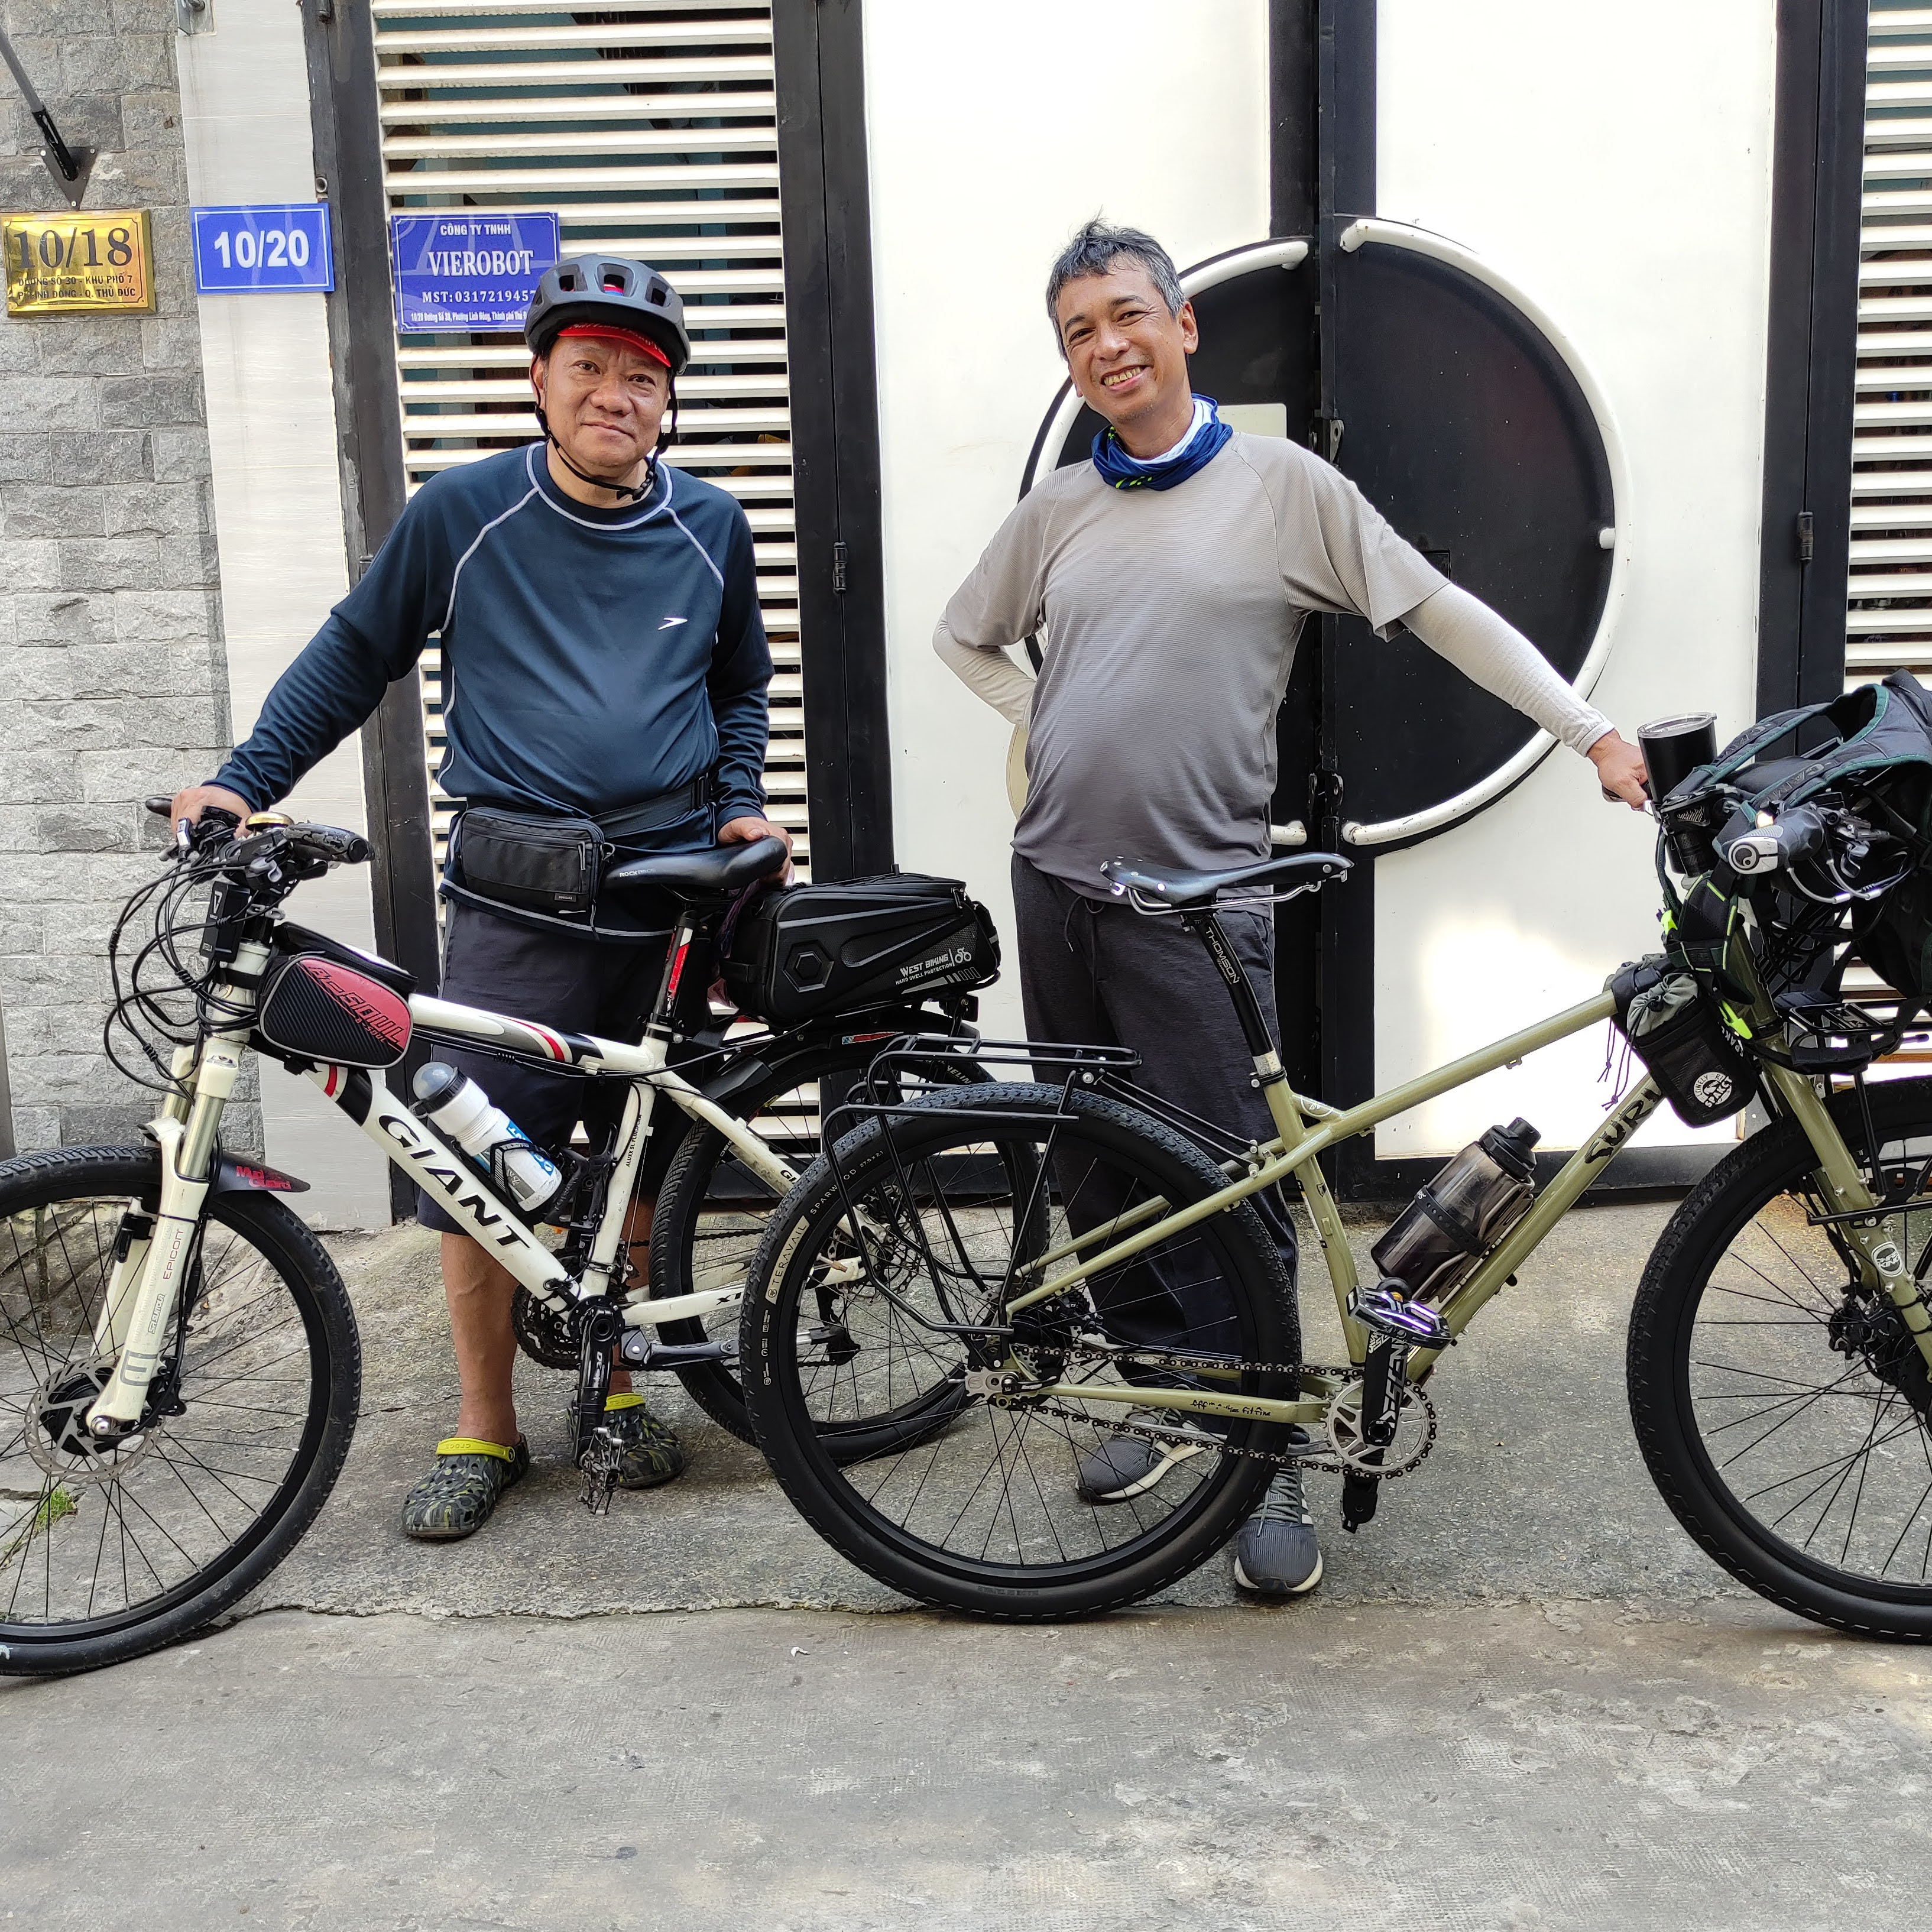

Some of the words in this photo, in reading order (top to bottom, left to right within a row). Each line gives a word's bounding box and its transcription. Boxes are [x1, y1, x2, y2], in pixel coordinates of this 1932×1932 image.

[440, 223, 468, 236] CÔNG
[470, 224, 482, 235] TY
[484, 224, 511, 235] TNHH
[14, 226, 132, 268] 10/18
[214, 229, 310, 268] 10/20
[427, 249, 534, 277] VIEROBOT
[65, 276, 76, 284] 30
[85, 275, 103, 284] KHU
[106, 271, 125, 284] PHỐ
[127, 275, 133, 283] 7
[96, 286, 114, 297] THỦ
[118, 287, 136, 297] ĐỨC
[900, 962, 923, 977] WEST
[925, 953, 949, 969] BIKING
[1206, 926, 1240, 984] THOMSON
[895, 976, 909, 986] HARD
[909, 973, 923, 981] SHELL
[924, 962, 952, 975] PROTECTION
[378, 1114, 530, 1249] GIANT
[771, 1224, 807, 1285] TERAVAIL
[810, 1169, 857, 1215] SPARWOD
